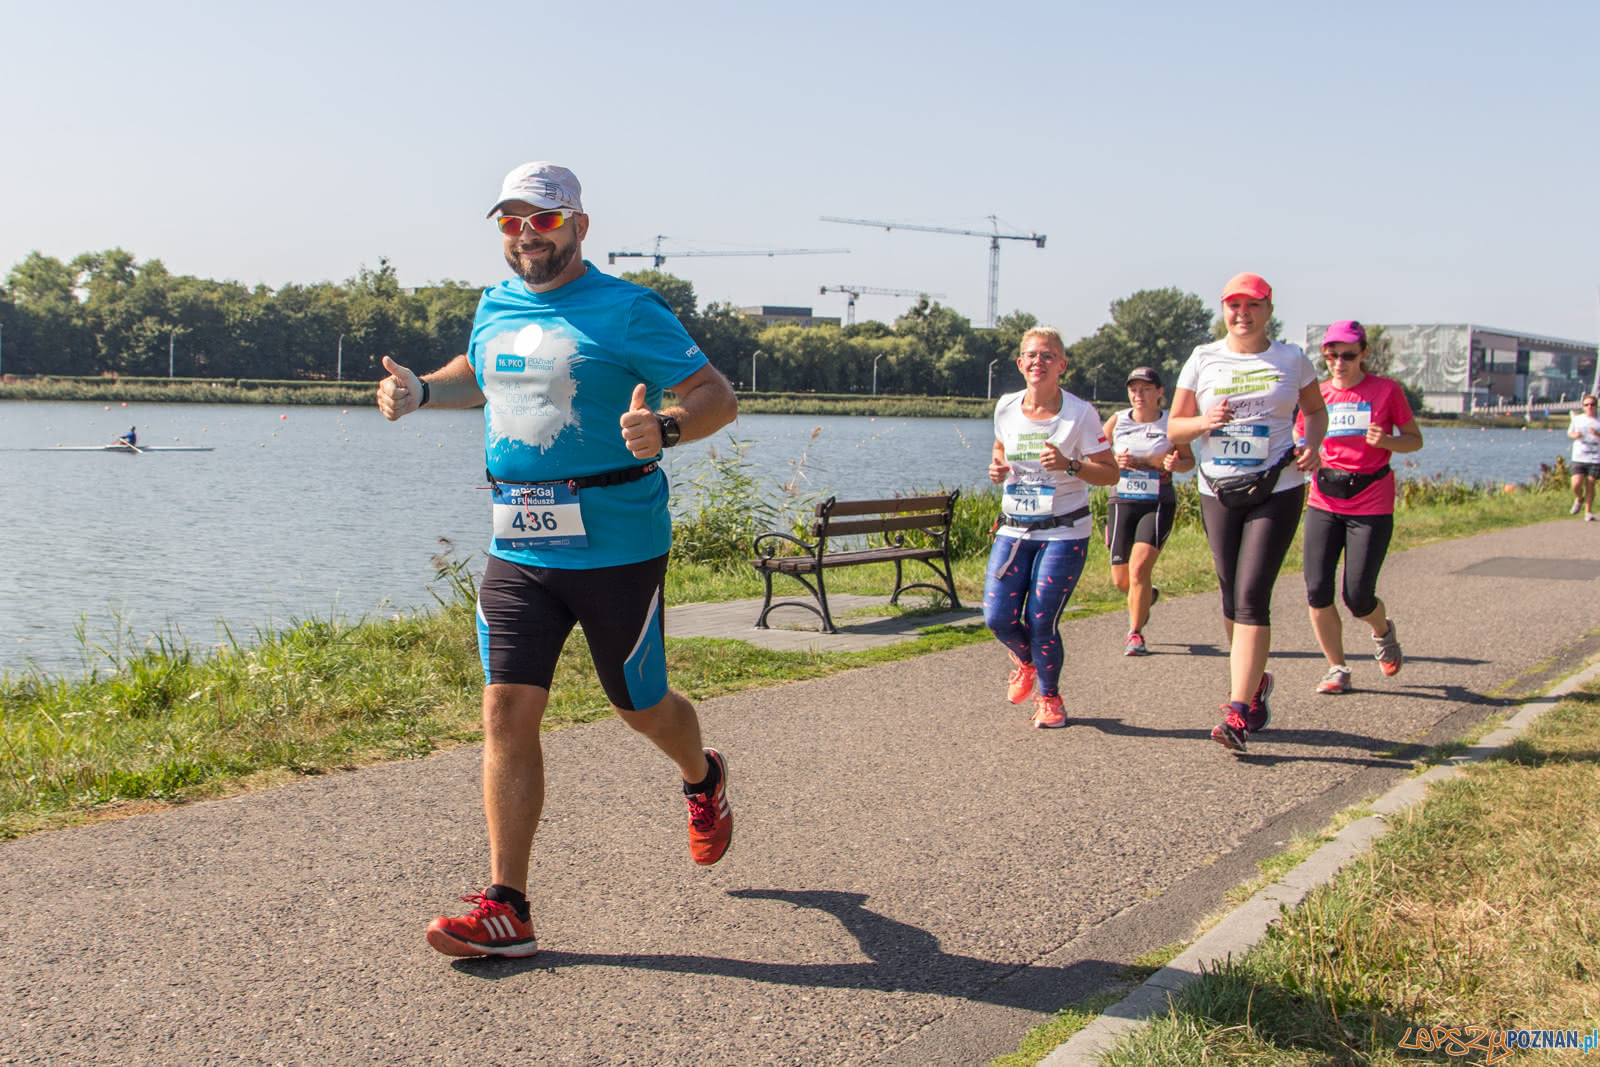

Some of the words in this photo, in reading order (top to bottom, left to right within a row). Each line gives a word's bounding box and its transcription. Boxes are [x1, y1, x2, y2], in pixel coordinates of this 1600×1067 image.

[508, 359, 524, 368] PKO
[1331, 414, 1355, 425] 440
[1221, 440, 1251, 455] 710
[1126, 480, 1148, 491] 690
[1015, 498, 1037, 512] 711
[512, 511, 558, 532] 436
